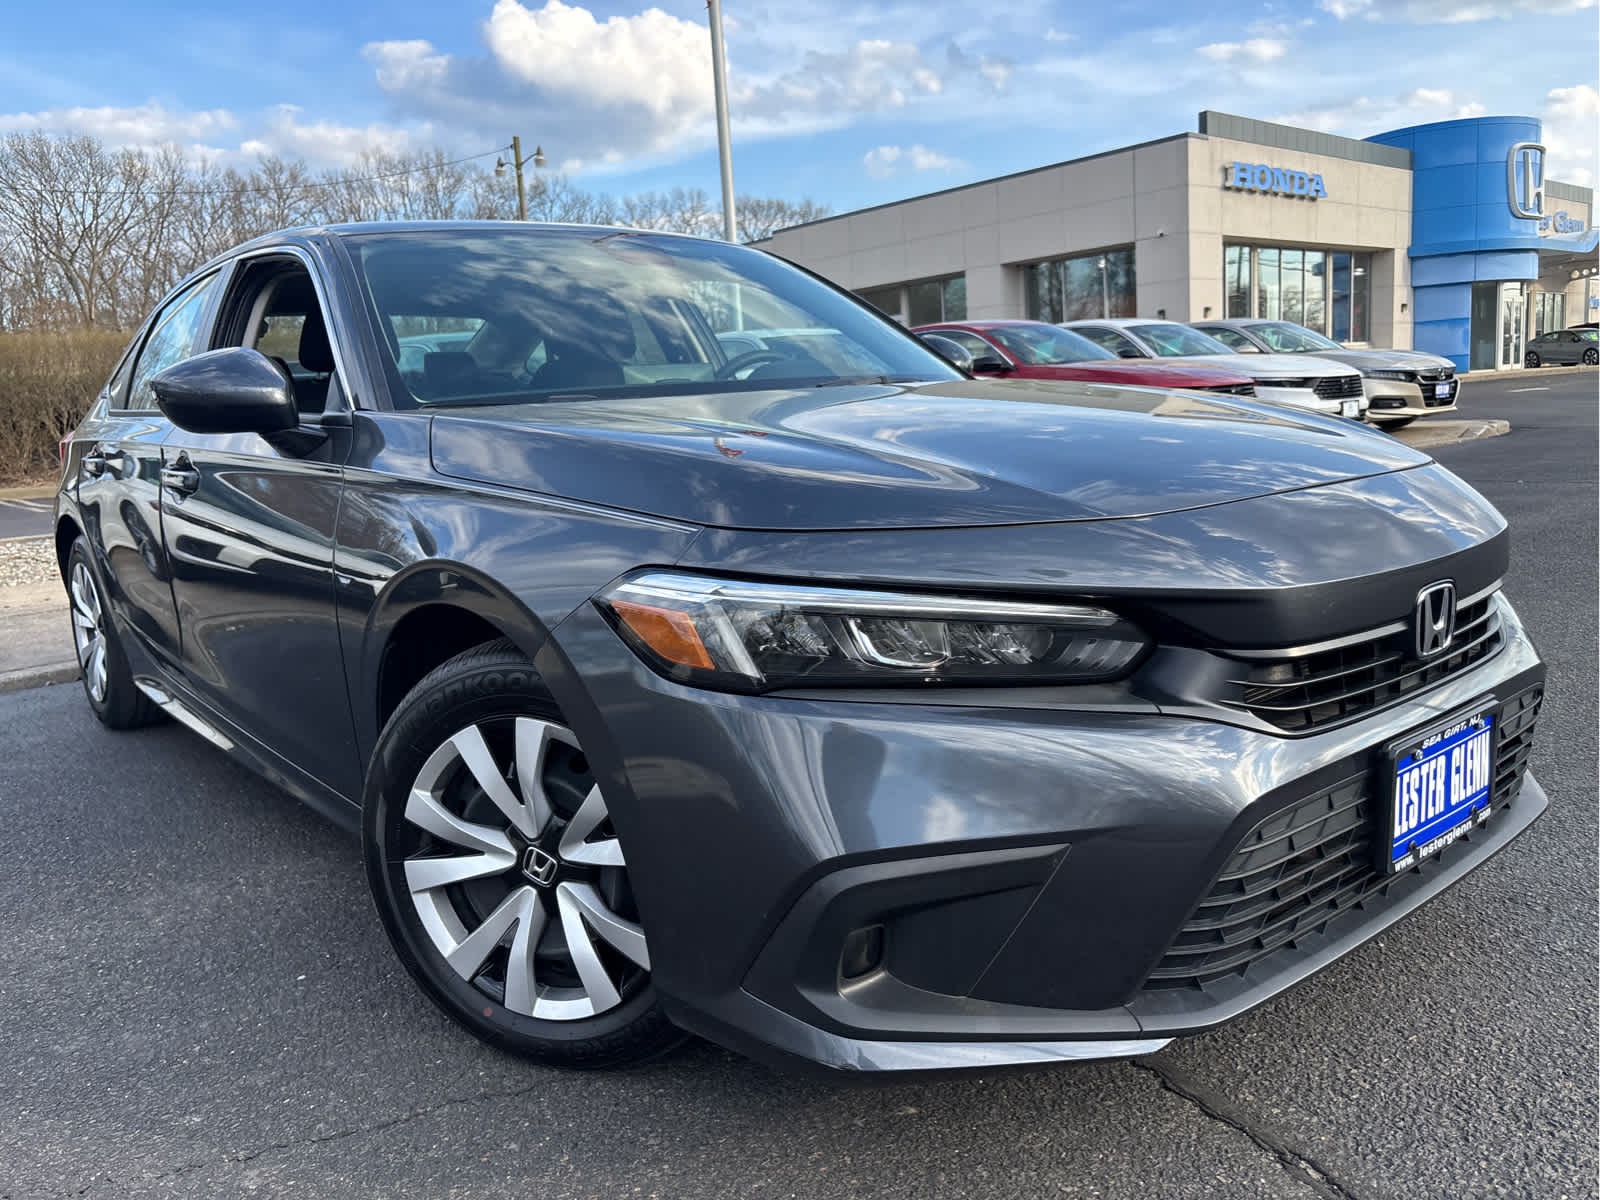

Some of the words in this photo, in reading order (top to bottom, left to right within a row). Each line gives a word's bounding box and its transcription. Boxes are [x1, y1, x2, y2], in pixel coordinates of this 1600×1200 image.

[1230, 161, 1328, 198] HONDA
[1422, 734, 1442, 749] SEA
[1394, 754, 1446, 838] LESTER
[1450, 730, 1490, 806] GLENN
[1419, 820, 1472, 858] lesterglenn
